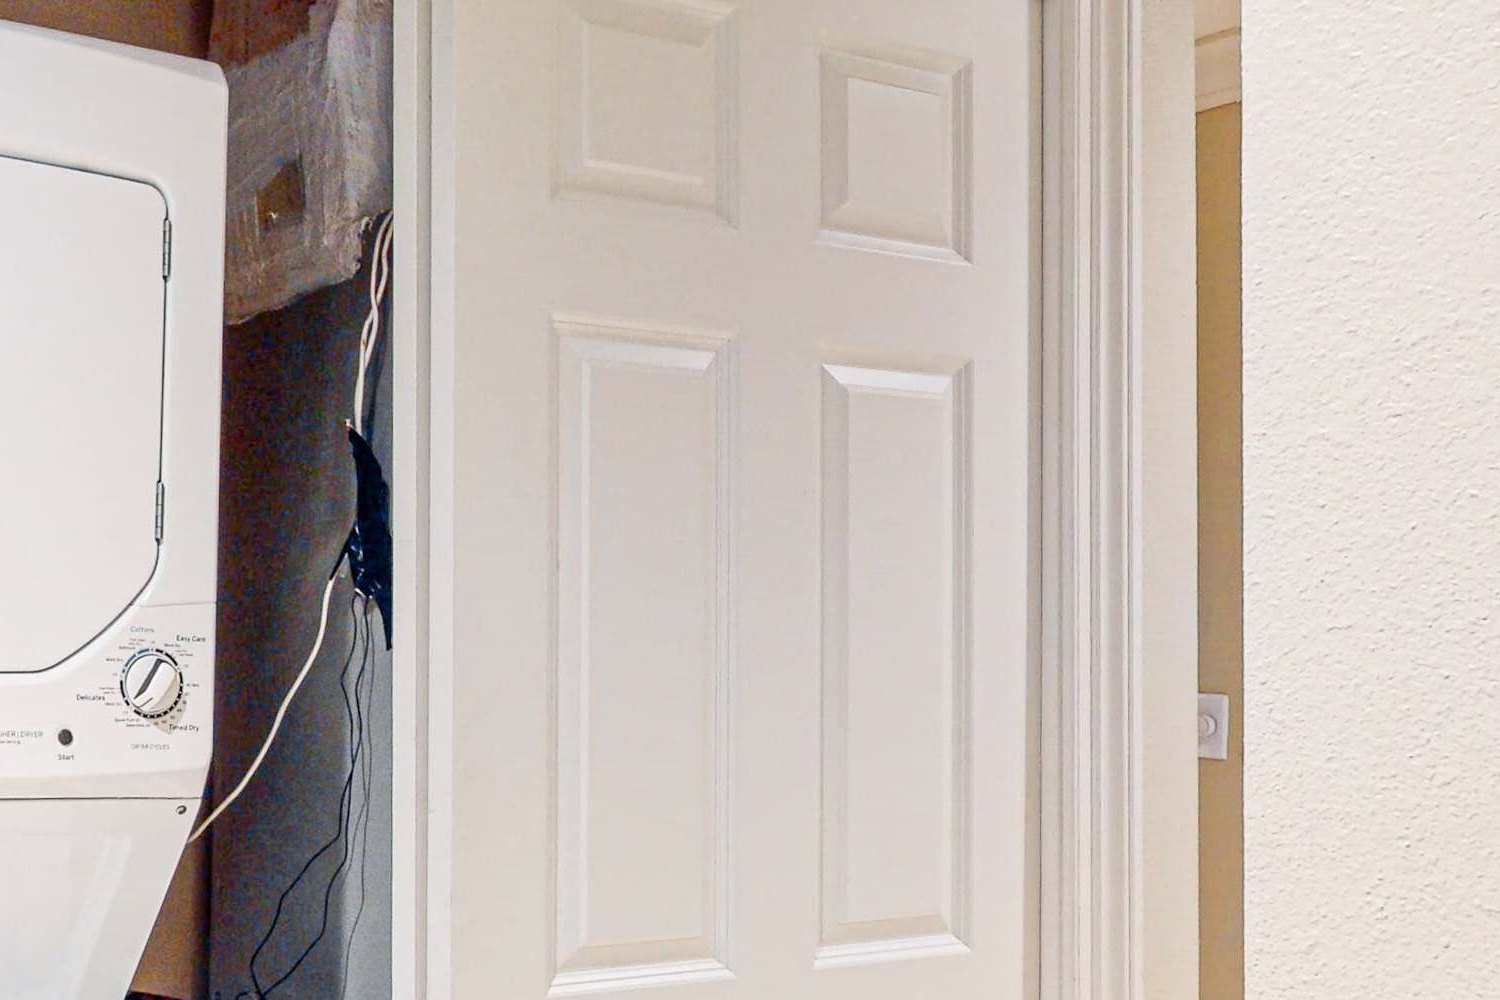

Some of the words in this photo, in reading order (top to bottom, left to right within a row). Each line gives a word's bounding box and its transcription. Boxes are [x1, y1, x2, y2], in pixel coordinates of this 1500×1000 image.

[176, 634, 191, 643] Easy
[76, 694, 106, 702] Delicates
[57, 753, 75, 761] Start
